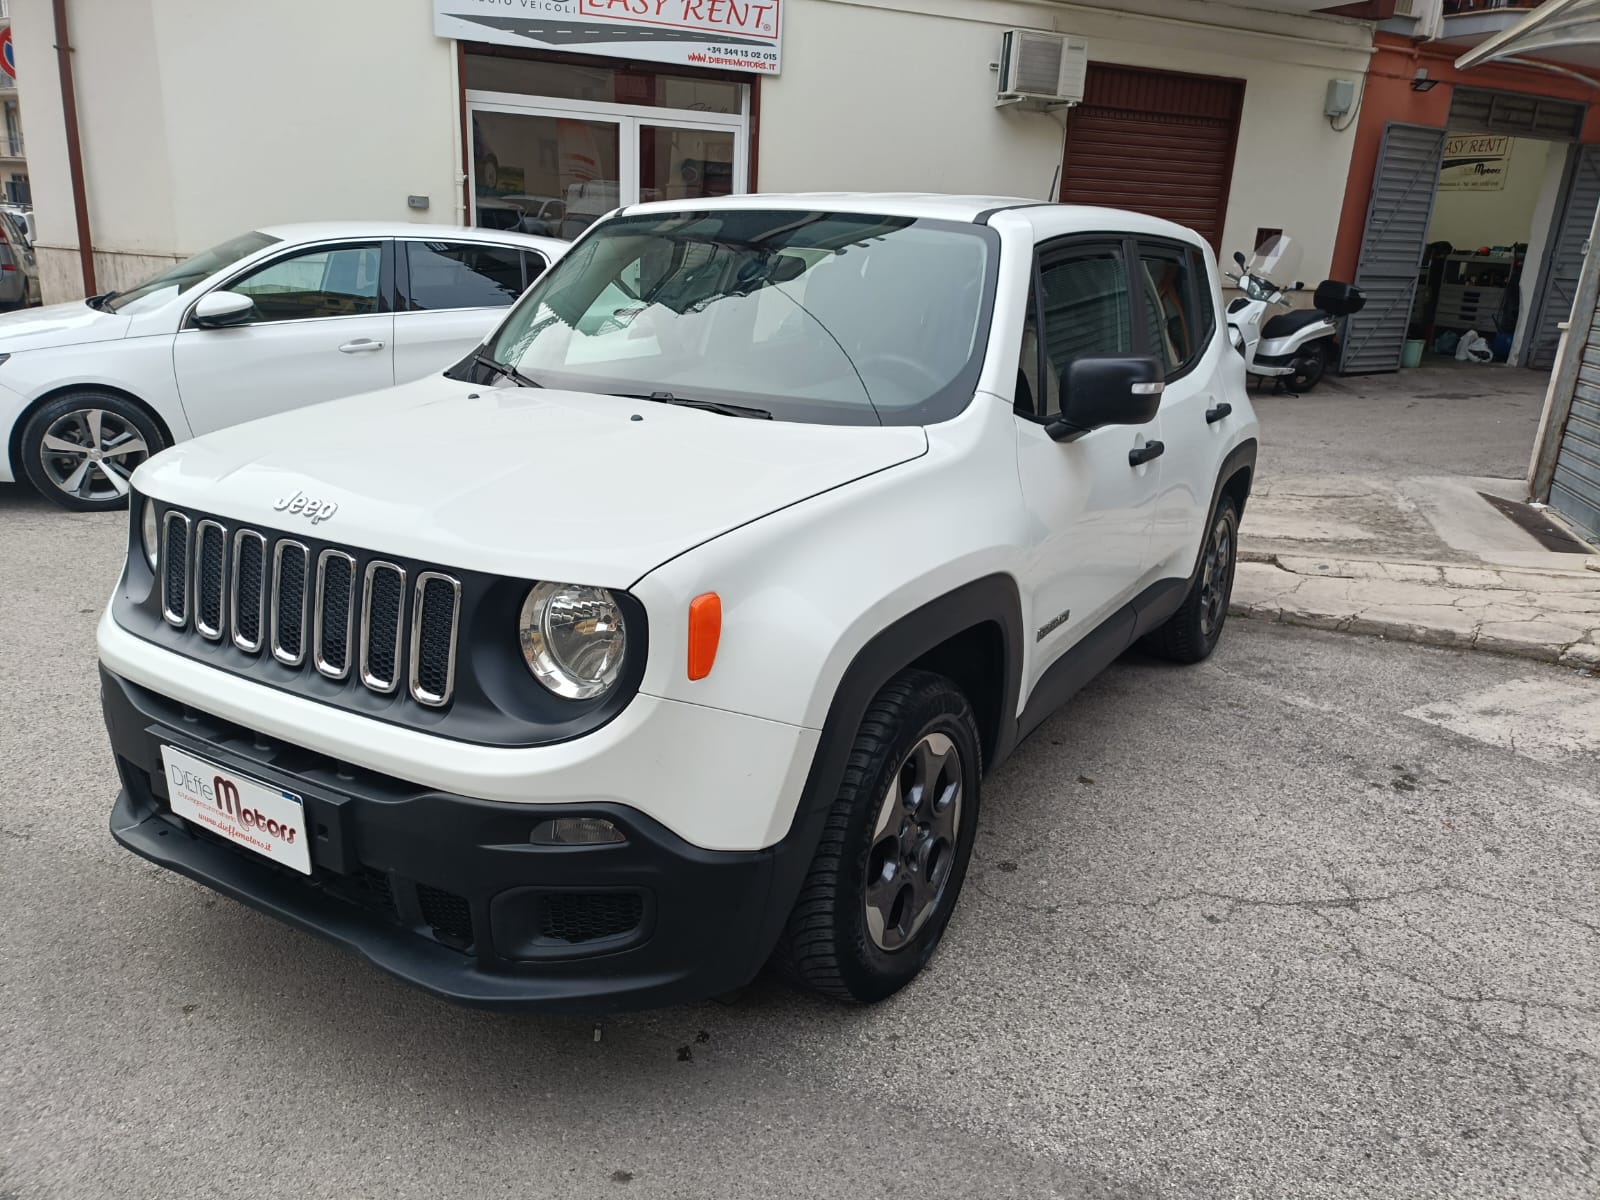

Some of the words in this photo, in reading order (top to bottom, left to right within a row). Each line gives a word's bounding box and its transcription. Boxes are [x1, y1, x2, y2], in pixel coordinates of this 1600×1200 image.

[520, 0, 576, 14] VEICOLI
[680, 0, 773, 28] RENT
[707, 46, 721, 54] +39
[724, 48, 738, 56] 349
[751, 51, 761, 59] 02
[1445, 139, 1468, 154] ASY
[1469, 137, 1506, 153] RENT
[273, 490, 338, 525] Jeep
[171, 764, 214, 801] DiEffe
[213, 775, 297, 844] Motors
